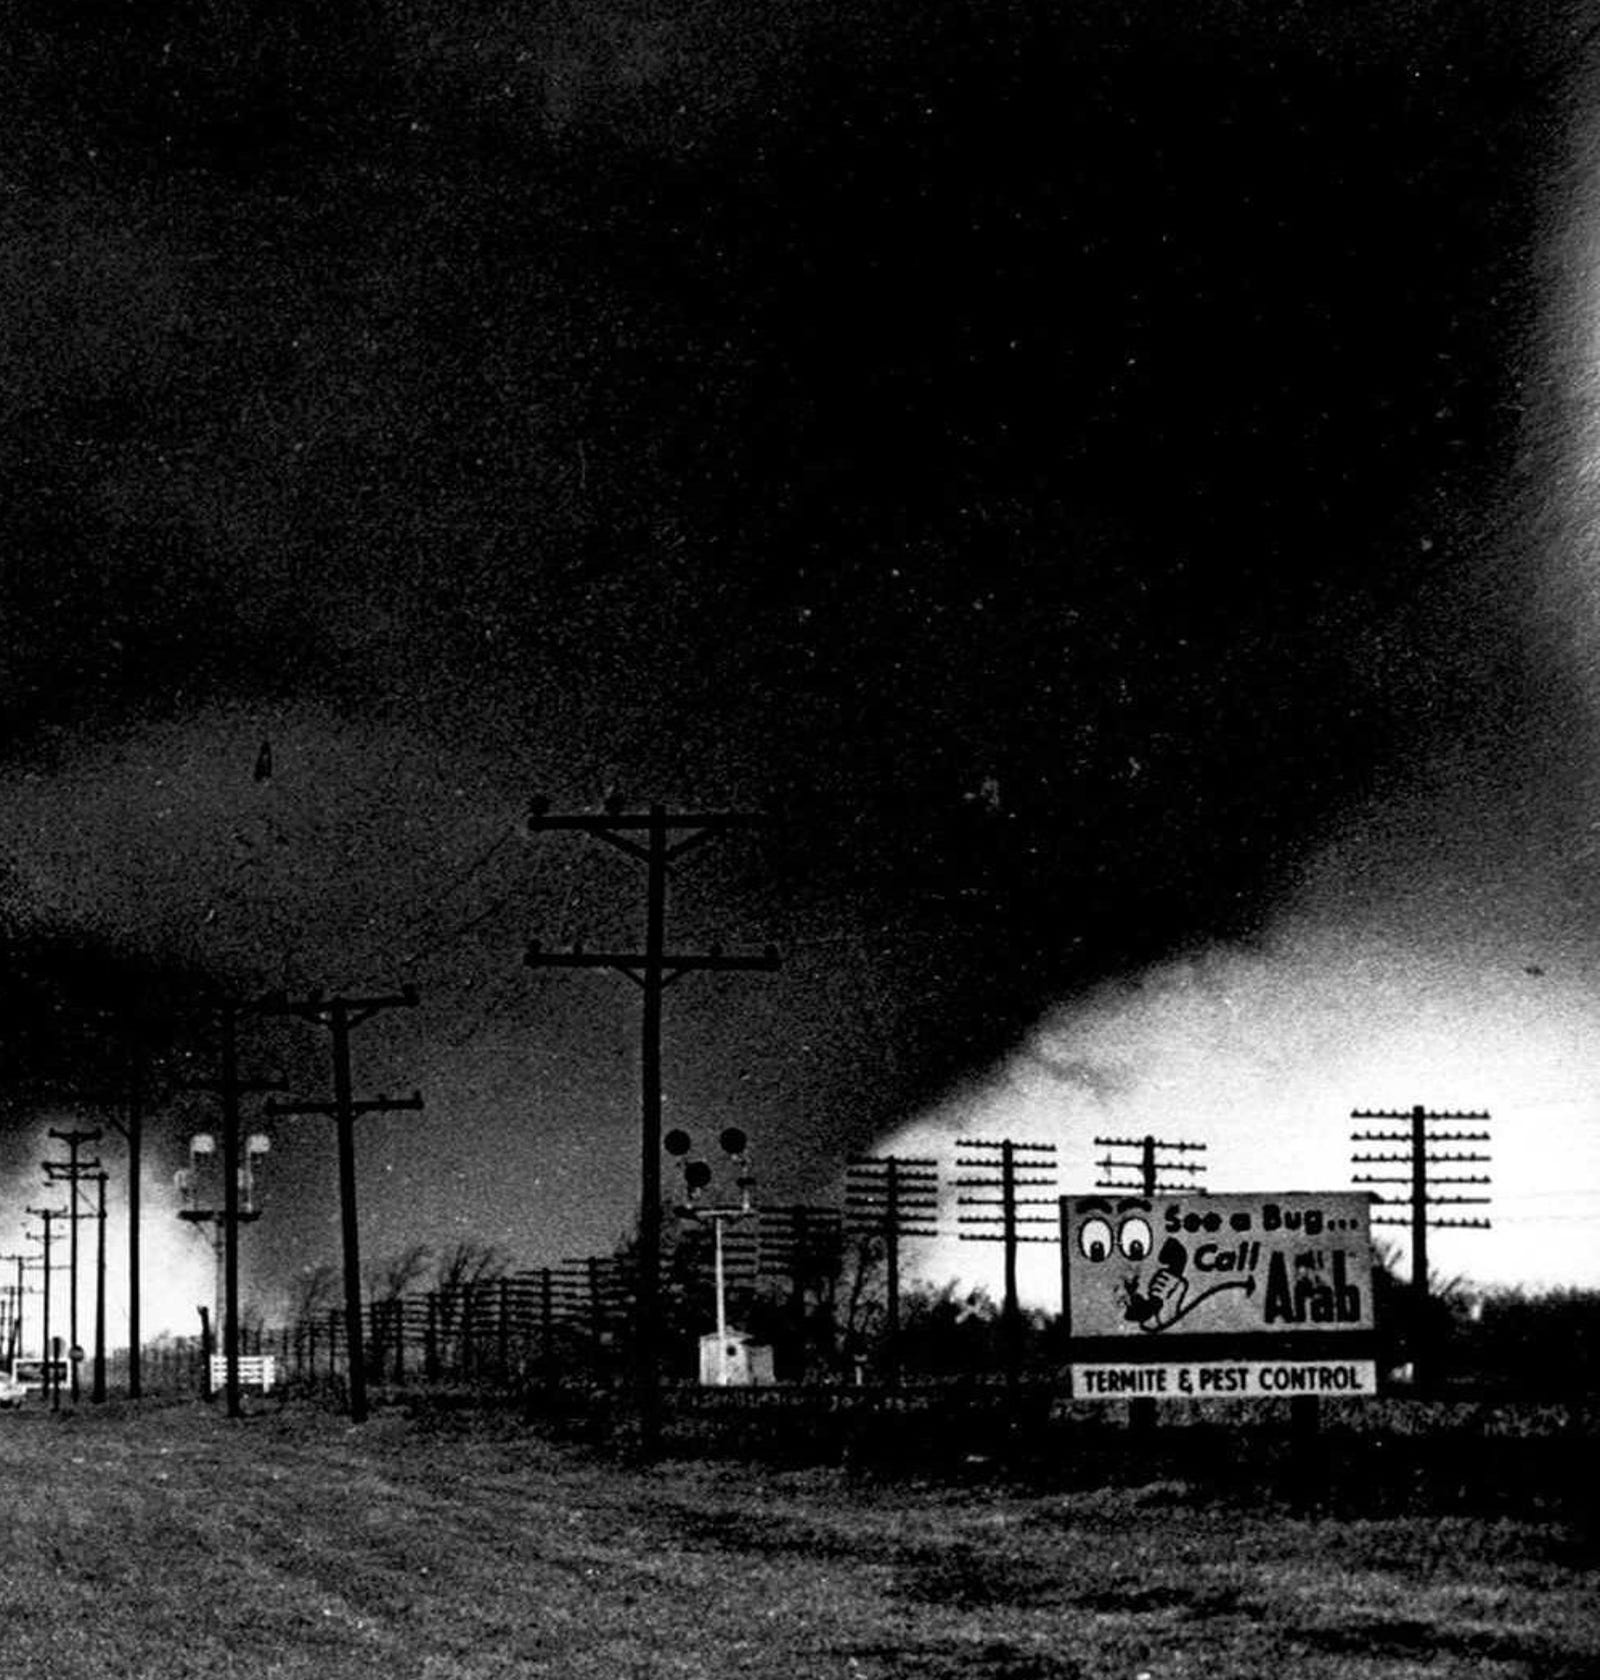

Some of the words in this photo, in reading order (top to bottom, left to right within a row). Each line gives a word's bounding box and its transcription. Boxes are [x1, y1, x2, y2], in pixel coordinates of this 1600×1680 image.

[1165, 1204, 1222, 1233] See
[1229, 1213, 1250, 1232] a
[1262, 1204, 1359, 1235] Bug...
[1194, 1241, 1261, 1272] Call
[1264, 1249, 1360, 1323] Arab
[1083, 1368, 1167, 1393] TERMITE
[1178, 1369, 1193, 1394] &
[1199, 1367, 1248, 1392] PEST
[1258, 1365, 1363, 1391] CONTROL
